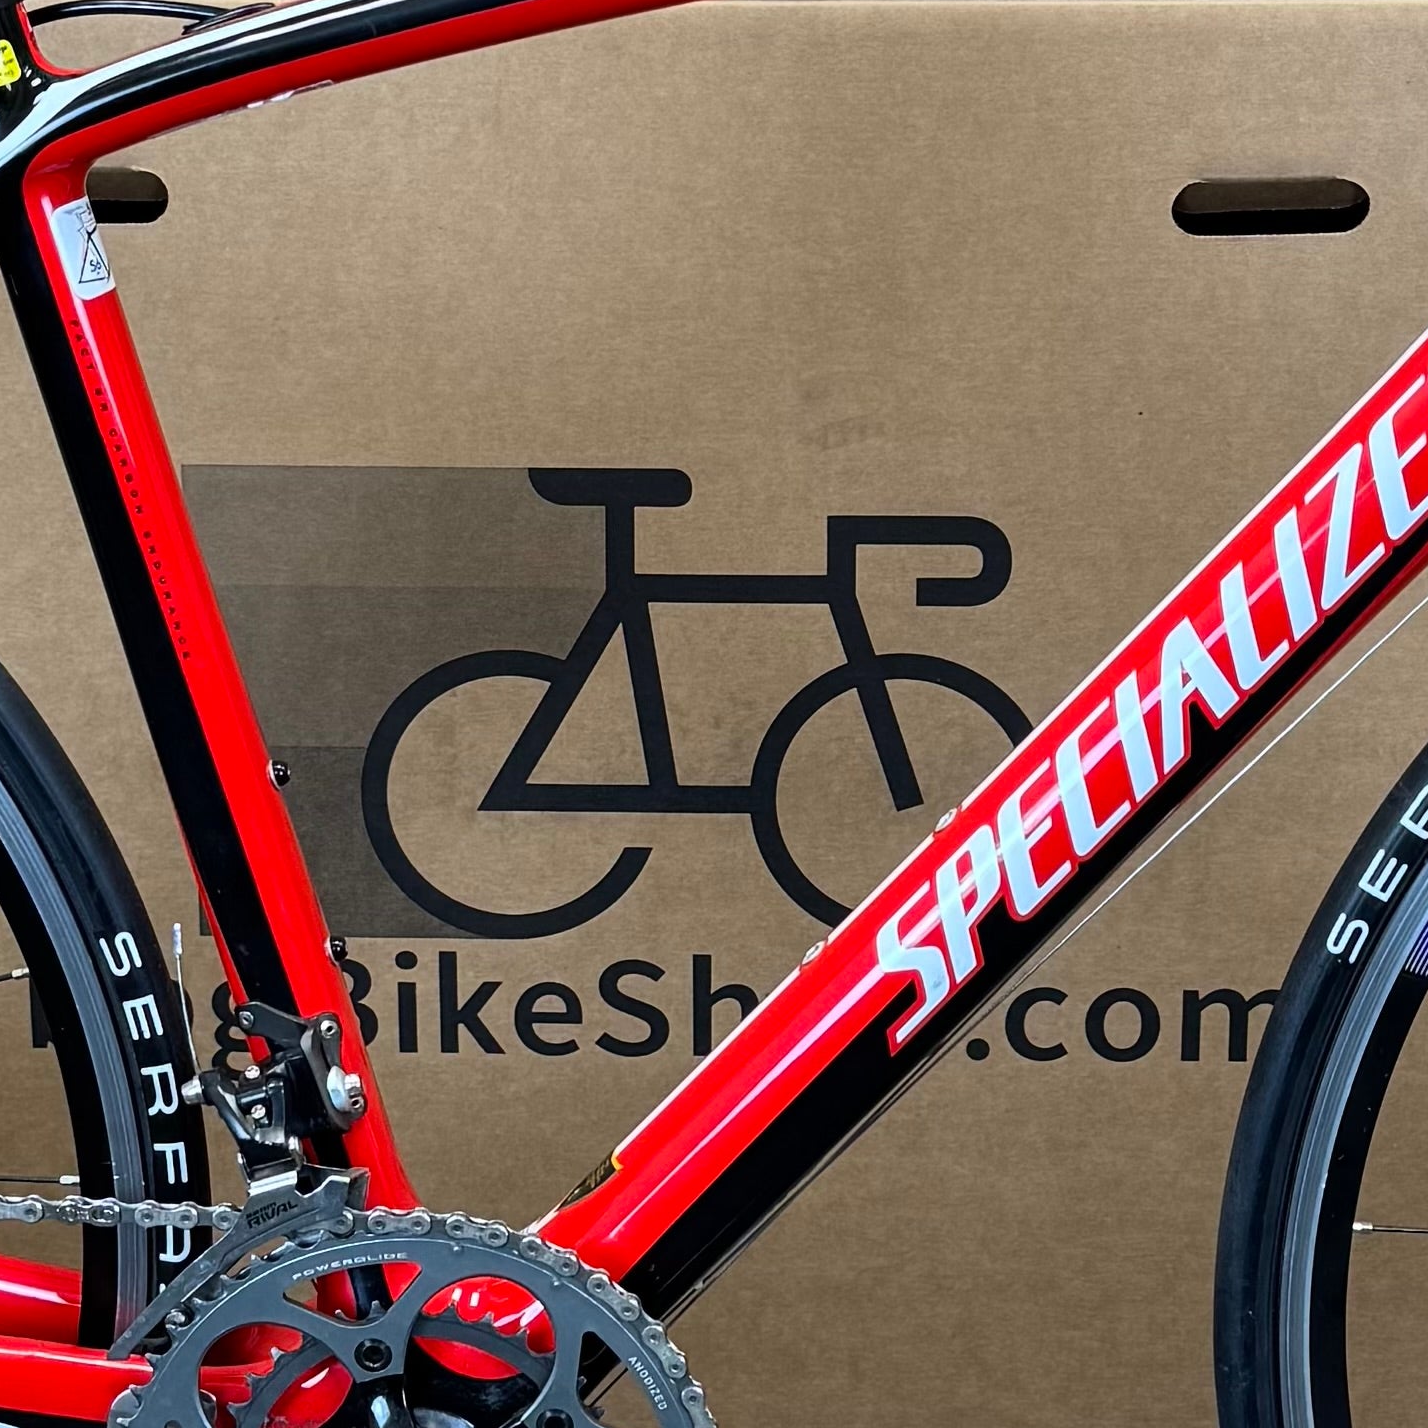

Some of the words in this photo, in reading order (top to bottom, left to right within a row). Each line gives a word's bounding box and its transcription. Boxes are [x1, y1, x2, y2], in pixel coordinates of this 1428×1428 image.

[247, 1200, 299, 1230] RIVAL
[292, 1251, 410, 1281] POWERGLIDE
[628, 1356, 668, 1411] ANODIZED
